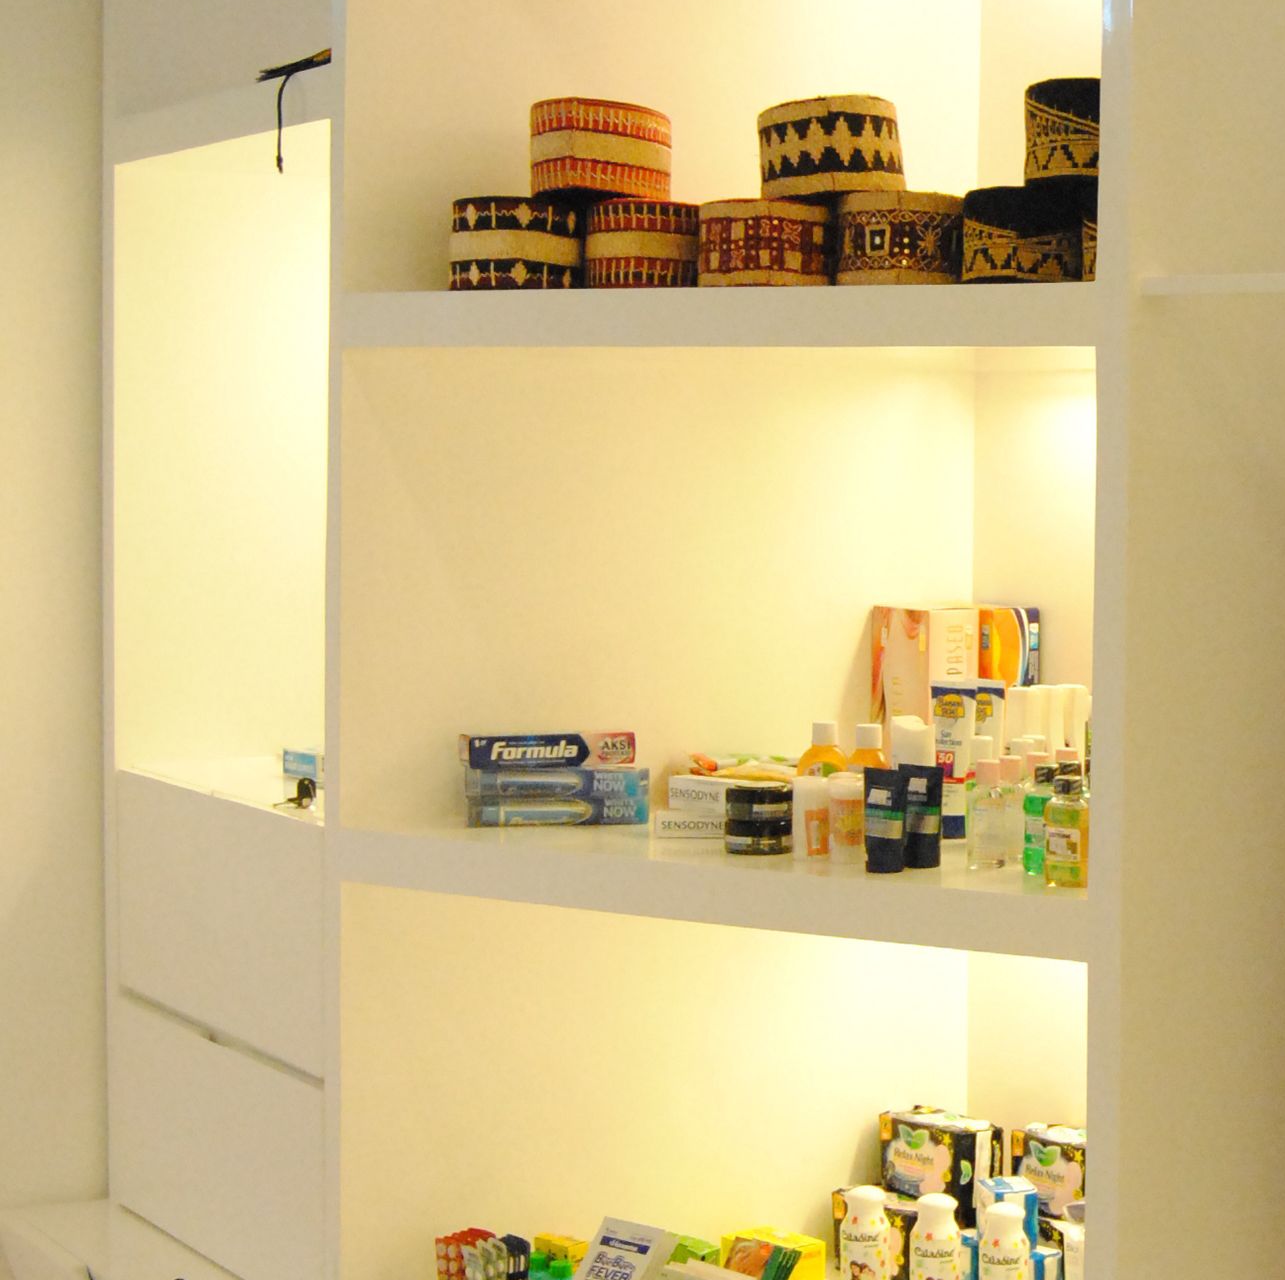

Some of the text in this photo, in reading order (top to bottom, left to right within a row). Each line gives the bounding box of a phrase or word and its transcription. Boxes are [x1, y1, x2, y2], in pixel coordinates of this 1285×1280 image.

[490, 740, 579, 761] Formula
[593, 780, 626, 792] NOW
[670, 787, 720, 802] SENSODYNE
[603, 806, 637, 818] NOW
[661, 820, 724, 830] SENSODYNE
